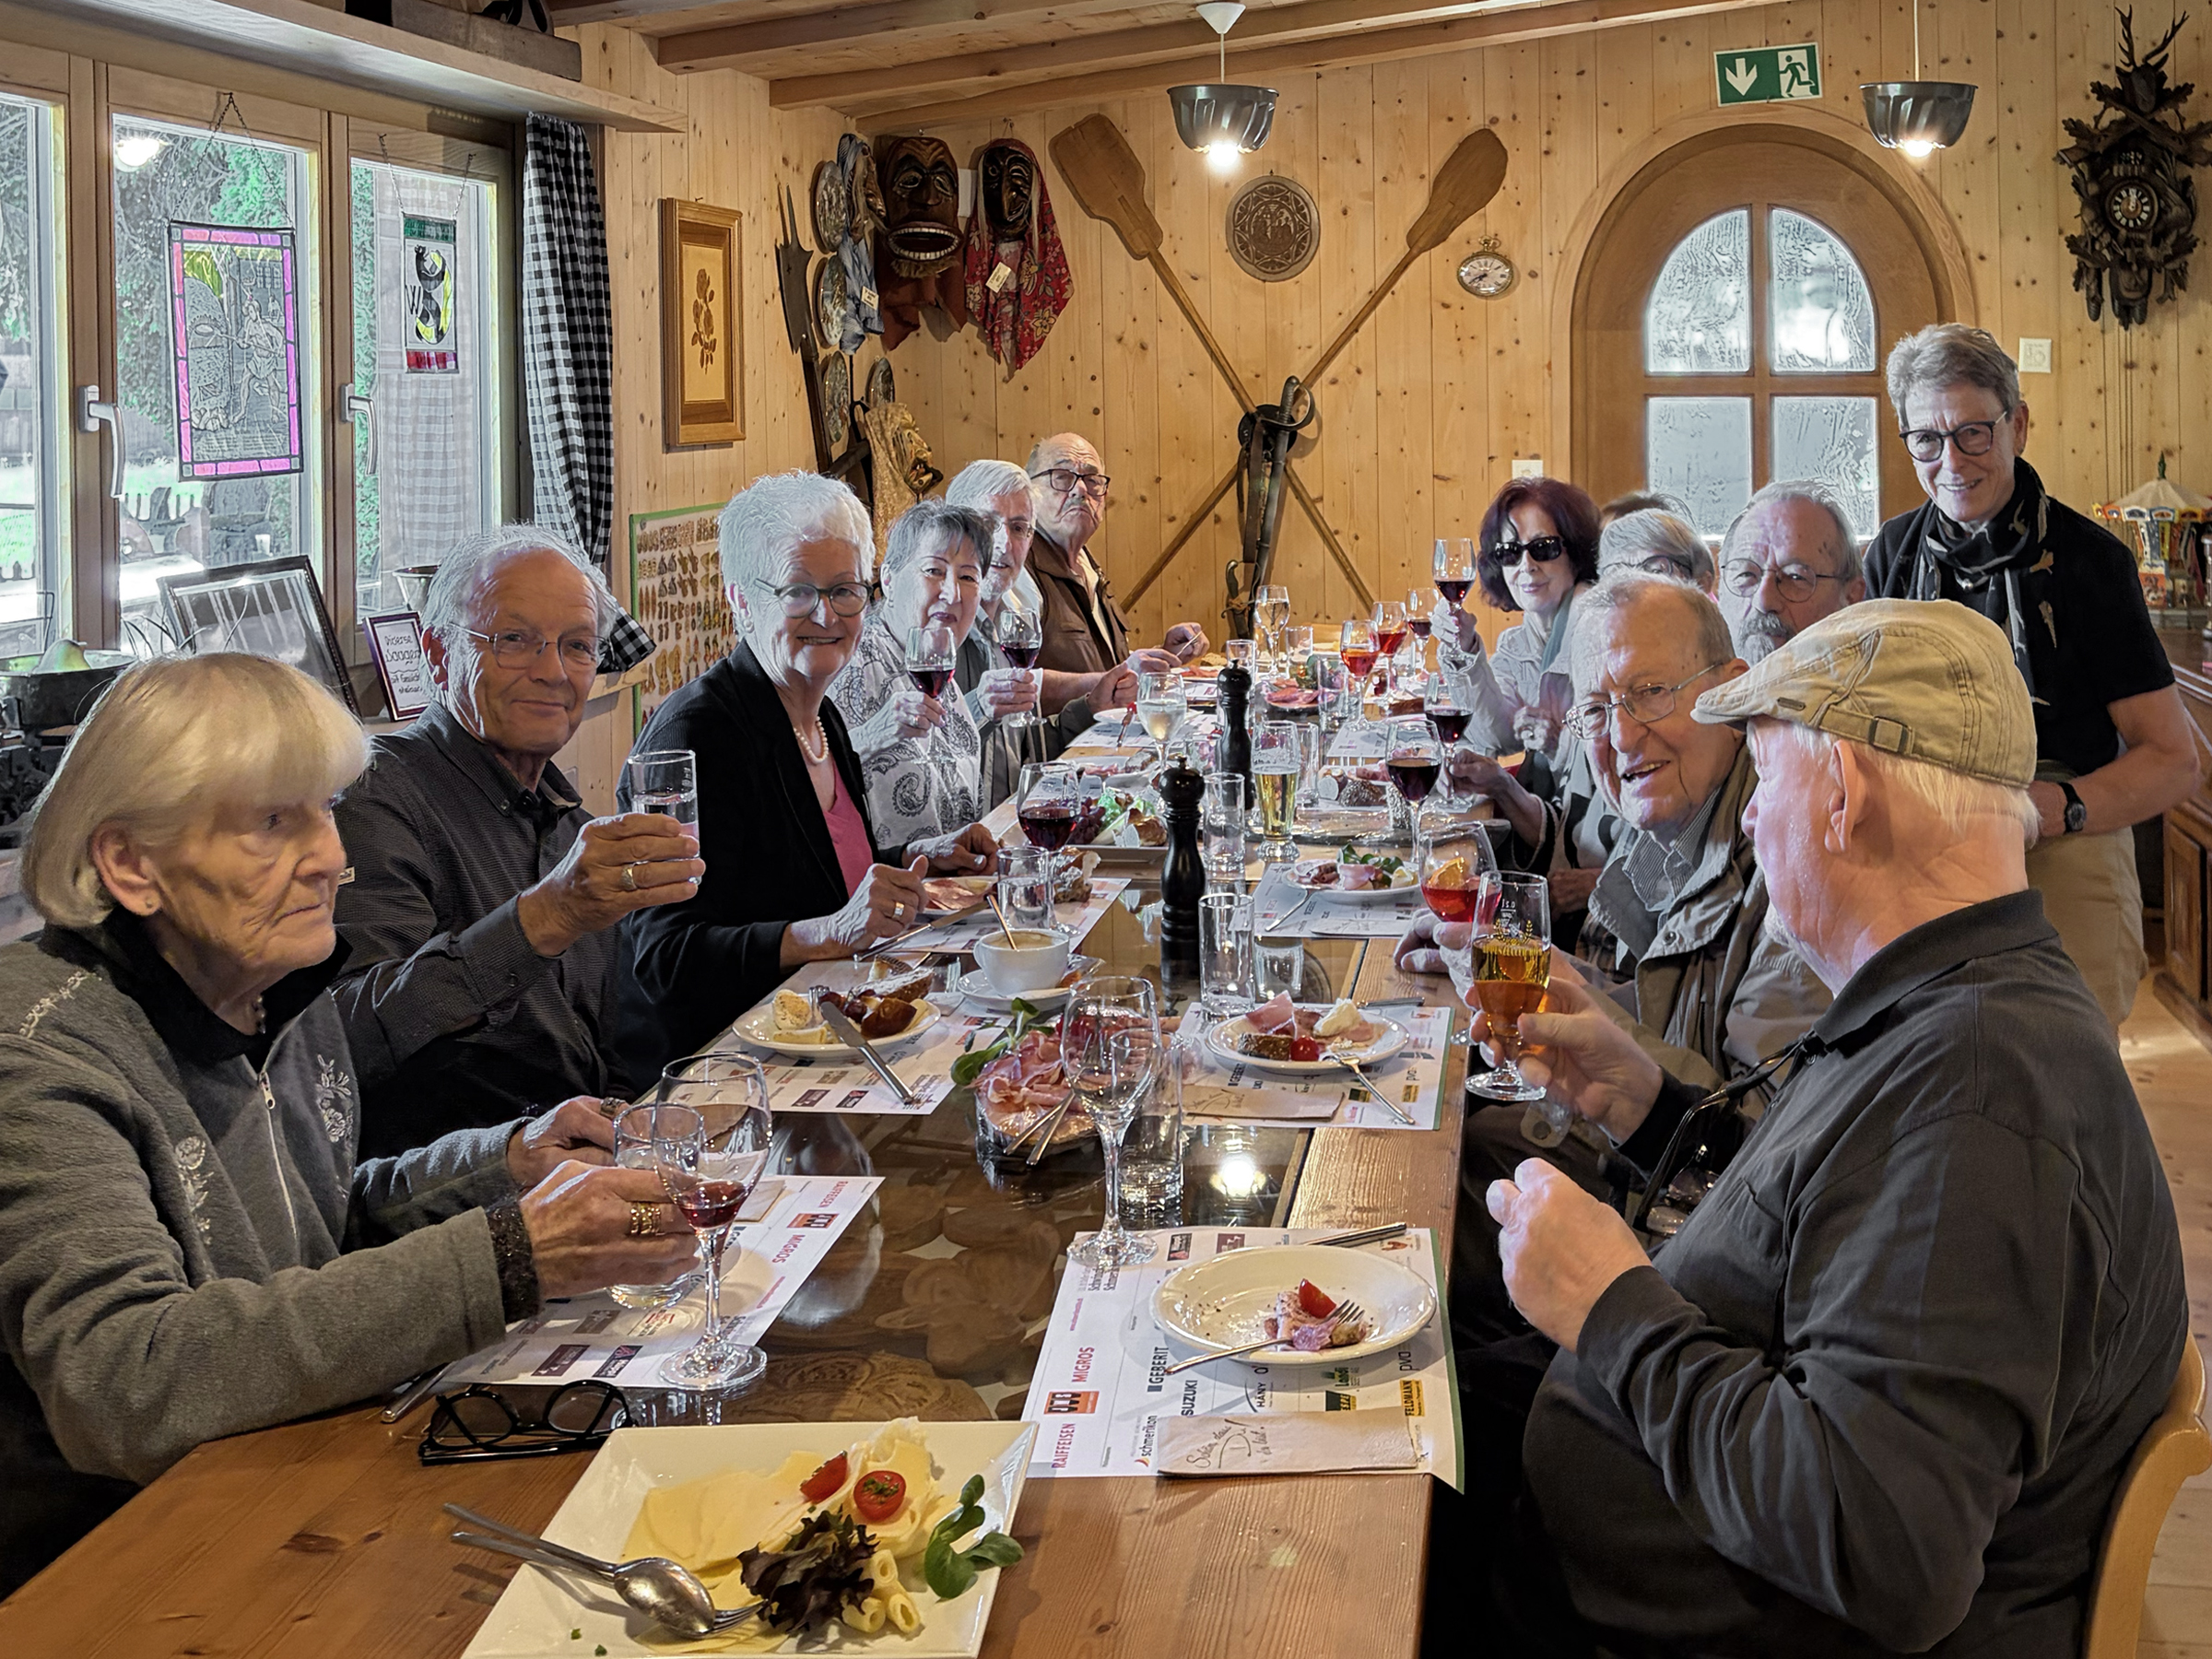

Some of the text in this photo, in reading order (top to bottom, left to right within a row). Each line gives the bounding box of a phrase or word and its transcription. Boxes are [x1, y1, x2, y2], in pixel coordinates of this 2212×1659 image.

[772, 1235, 806, 1264] MIGROS
[1072, 1347, 1095, 1382] MIGROS
[1148, 1347, 1169, 1384] GEBERIT
[1181, 1380, 1198, 1417] SUZUKI
[1402, 1380, 1415, 1417] FELDMANN
[1052, 1423, 1076, 1468] RAIFFEISEN
[1139, 1416, 1158, 1456] schmerikon
